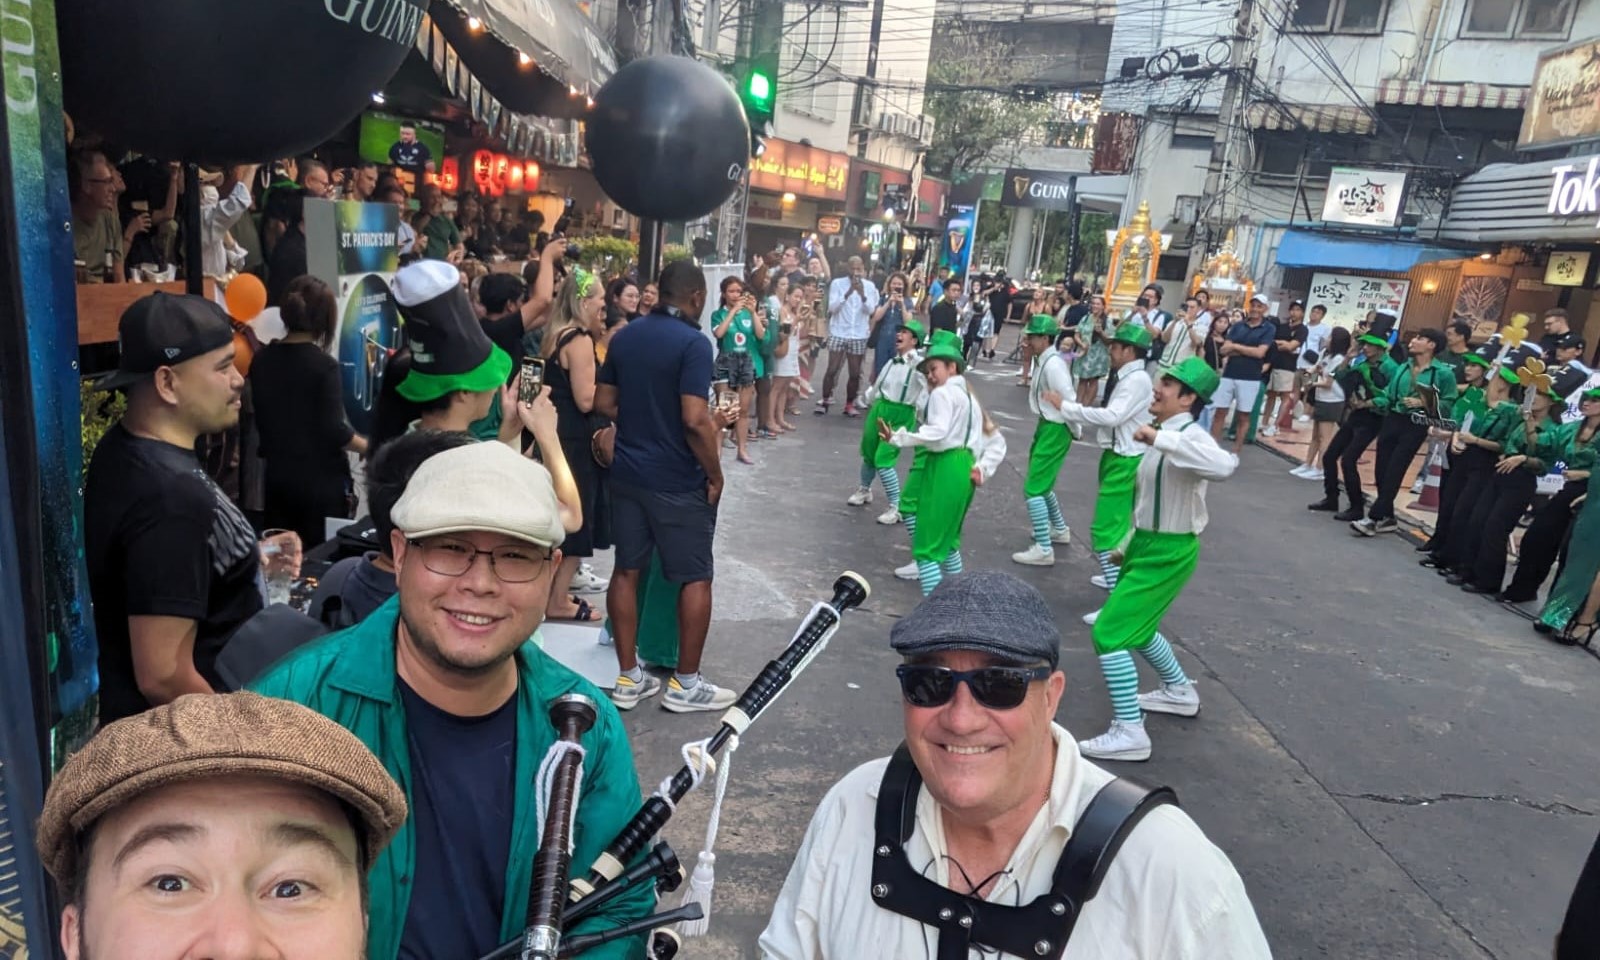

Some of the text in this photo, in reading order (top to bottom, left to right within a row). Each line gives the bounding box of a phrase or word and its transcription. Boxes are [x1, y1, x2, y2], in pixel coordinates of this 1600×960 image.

[0, 0, 37, 114] GU
[1547, 157, 1600, 215] Tok
[342, 231, 395, 248] ST. PATRICK'S DAY
[1359, 291, 1394, 300] 2nd Floor
